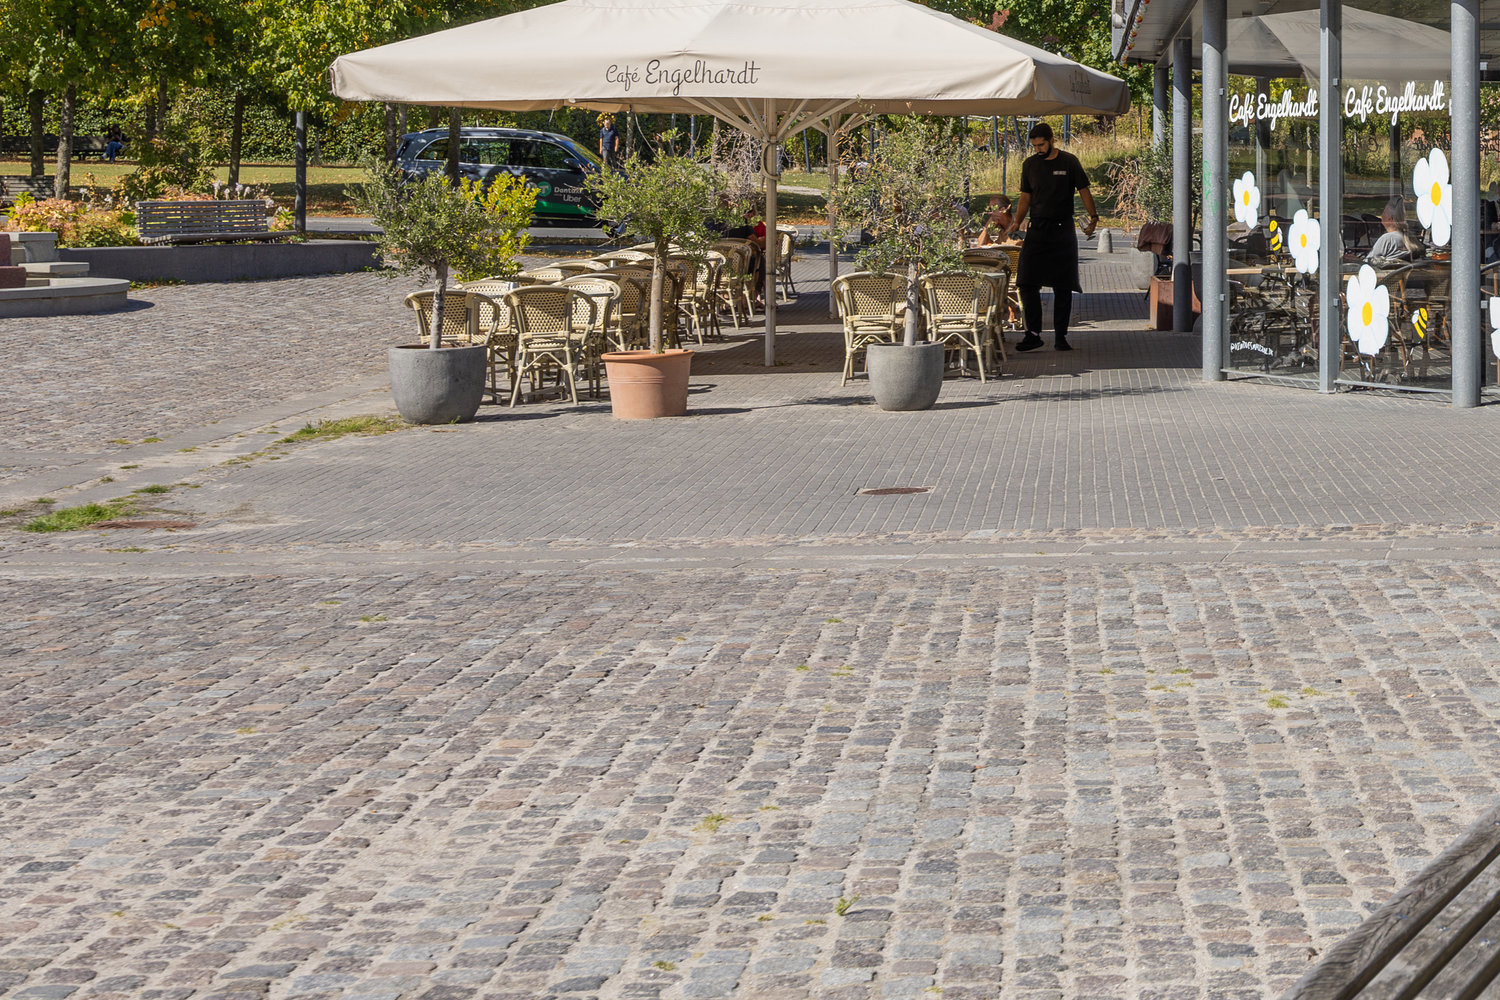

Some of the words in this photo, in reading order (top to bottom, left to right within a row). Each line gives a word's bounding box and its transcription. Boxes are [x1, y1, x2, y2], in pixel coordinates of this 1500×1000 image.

[605, 64, 641, 92] Café
[645, 59, 761, 97] Engelhardt
[1229, 93, 1255, 128] Café
[1256, 88, 1319, 131] Engelhardt
[1344, 85, 1374, 123] Café
[1375, 79, 1445, 126] Engelhardt
[563, 194, 582, 202] Uber
